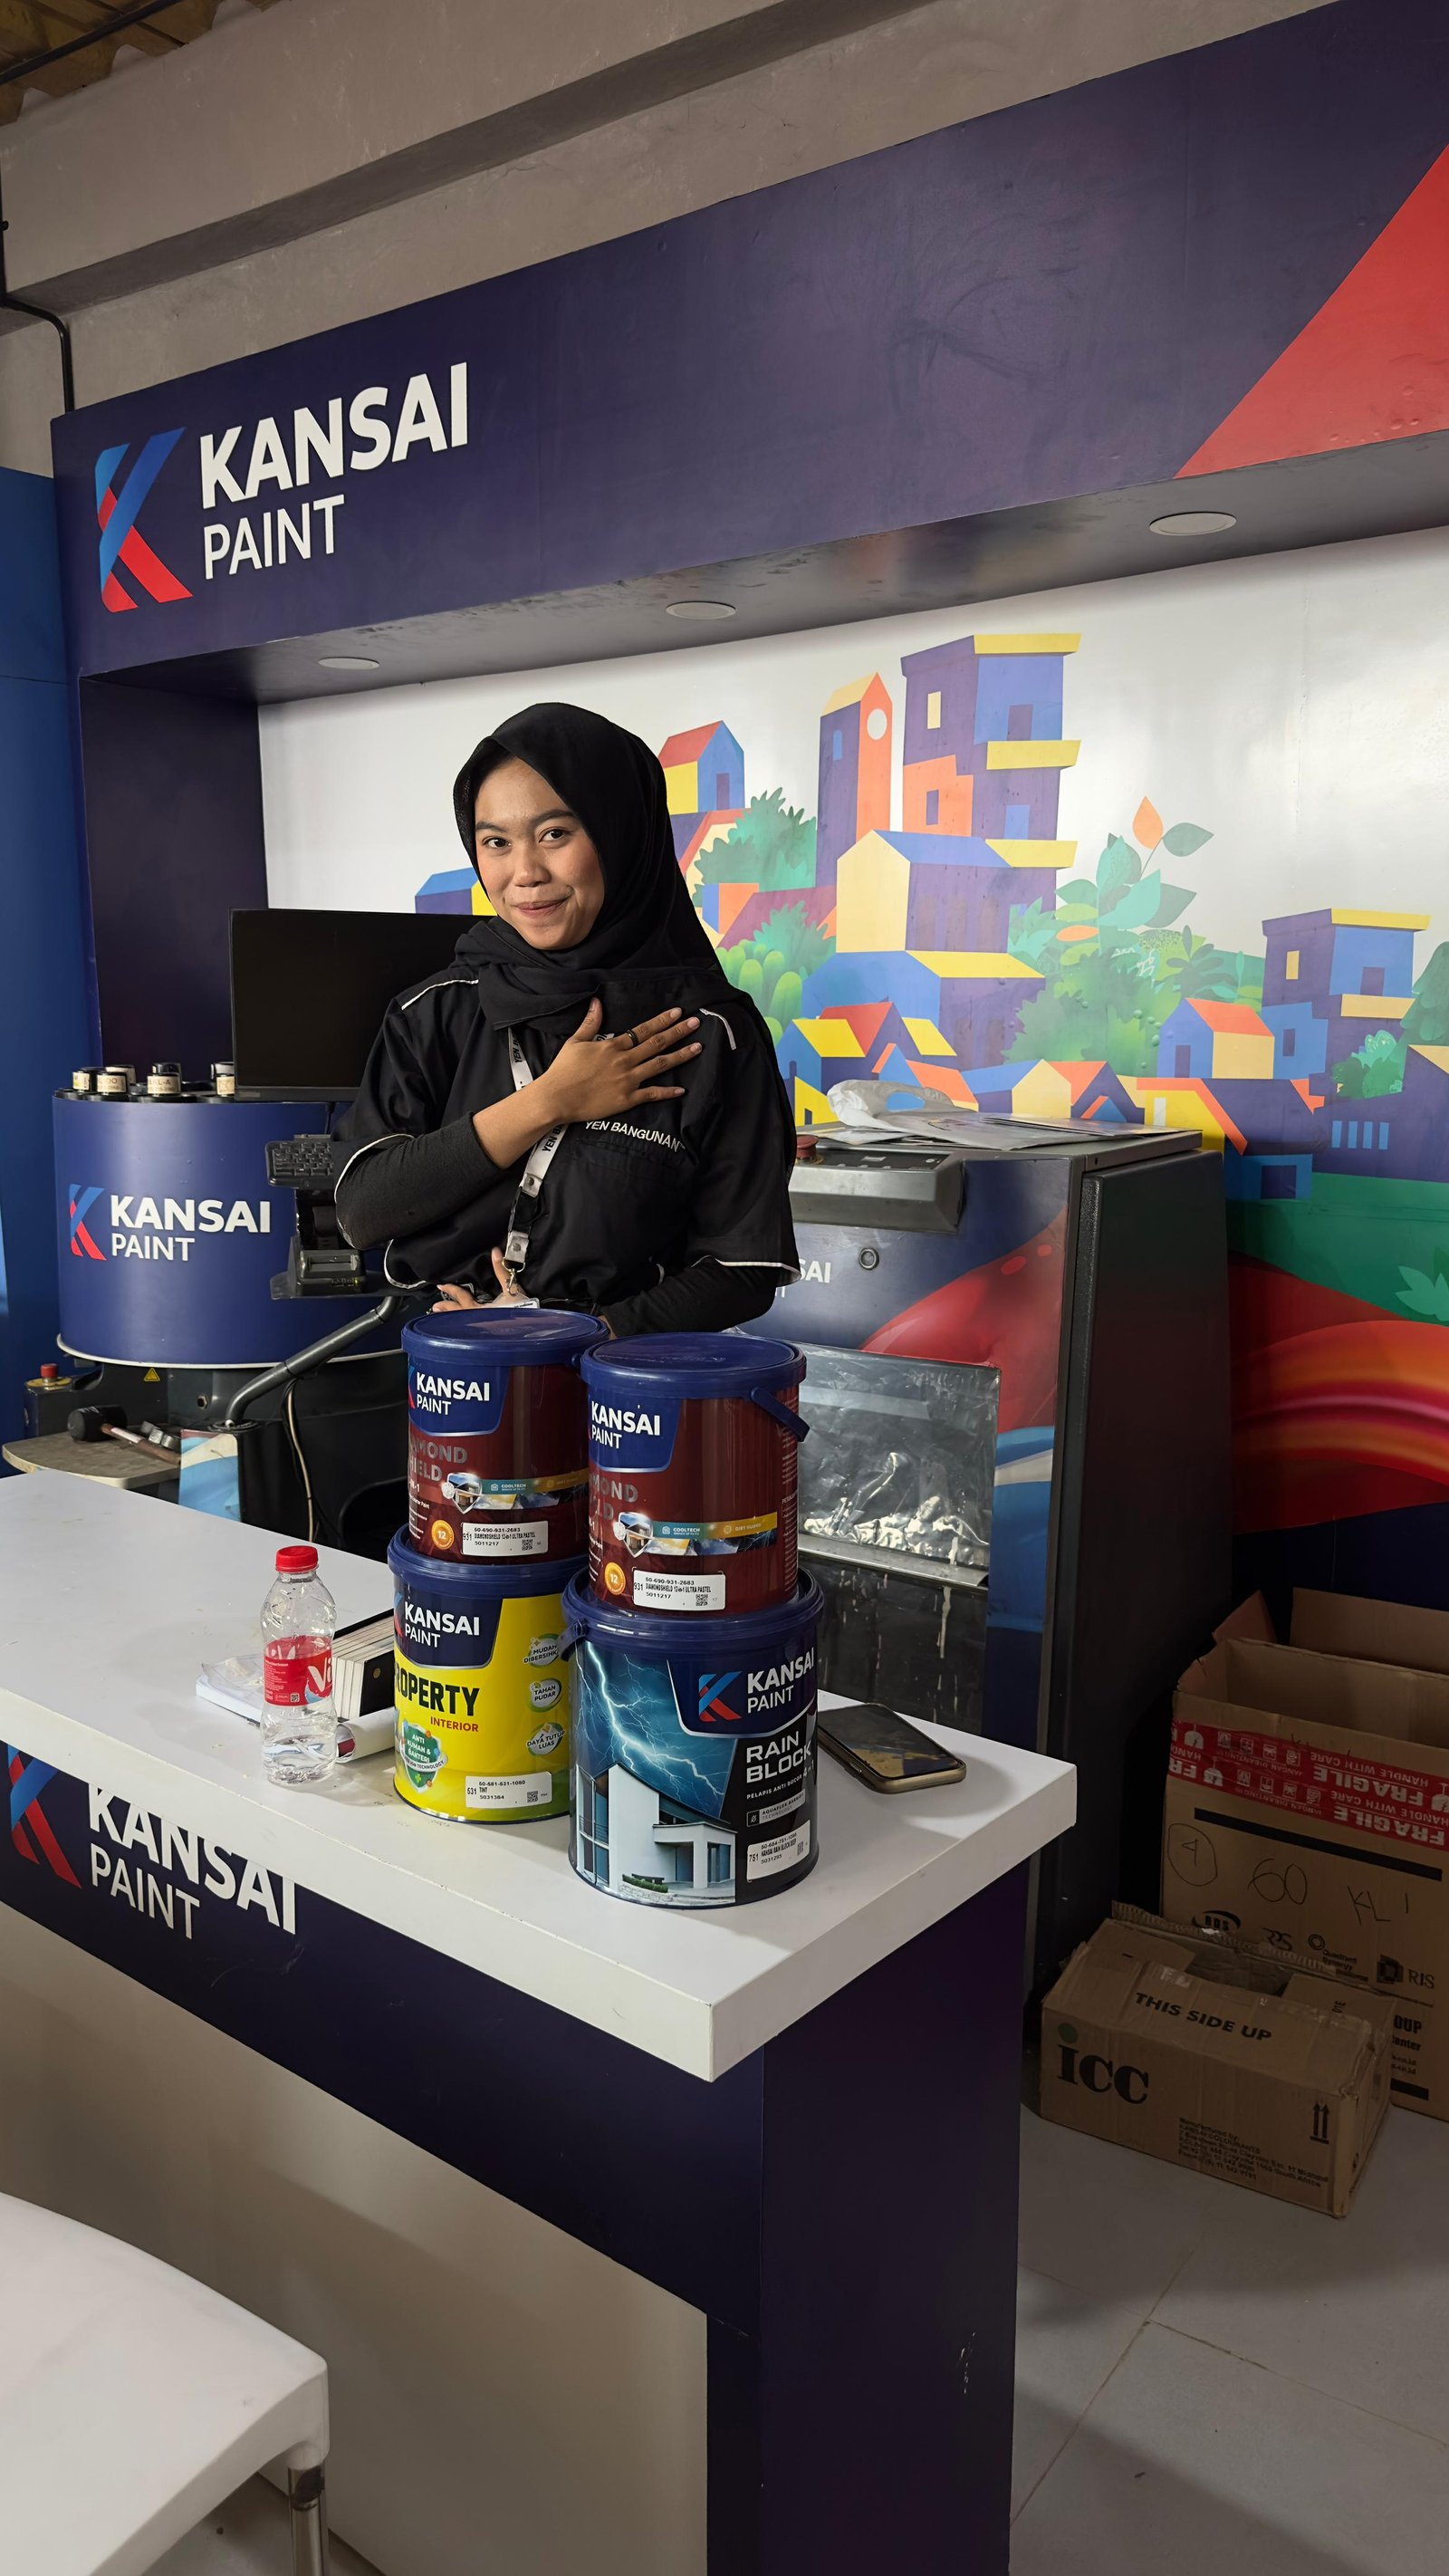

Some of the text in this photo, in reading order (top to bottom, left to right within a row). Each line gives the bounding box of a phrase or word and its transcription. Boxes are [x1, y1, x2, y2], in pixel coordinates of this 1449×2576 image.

[200, 362, 468, 509] KANSAI
[203, 495, 345, 580] PAINT
[542, 1136, 558, 1153] YEN
[610, 1121, 681, 1153] BANGUNAN
[110, 1195, 271, 1234] KANSAI
[111, 1233, 196, 1262] PAINT
[416, 1371, 490, 1402] KANSAI
[417, 1396, 452, 1416] PAINT
[590, 1400, 661, 1437] KANSAI
[591, 1427, 623, 1449] PAINT
[437, 1530, 446, 1540] 12
[609, 1573, 619, 1584] 12
[634, 1582, 644, 1591] 931
[404, 1600, 480, 1636] KANSAI
[405, 1623, 441, 1648] PAINT
[523, 1649, 559, 1663] DIBERSIHK
[533, 1644, 557, 1655] MUDAH
[747, 1647, 814, 1695] KANSAI
[533, 1685, 556, 1696] TAHAN
[534, 1691, 556, 1702] PUDAR
[747, 1685, 794, 1714] PAINT
[430, 1716, 479, 1732] INTERIOR
[407, 1739, 426, 1754] KUMAN
[411, 1734, 425, 1744] ANTI
[527, 1737, 544, 1746] DAYA
[539, 1741, 555, 1750] LUAS
[746, 1730, 800, 1764] RAIN
[408, 1749, 430, 1763] BAKTERI
[746, 1739, 812, 1783] BLOCK
[1310, 1751, 1429, 1788] HANDLE WITH CARE
[466, 1787, 477, 1795] 531
[746, 1788, 772, 1800] PELAPIS
[772, 1783, 787, 1792] ANTI
[1313, 1765, 1425, 1806] FRAGILE
[1330, 1790, 1362, 1805] CARE
[1365, 1799, 1396, 1814] WITH
[1333, 1804, 1445, 1846] FRAGILE
[88, 1783, 296, 1936] KANSAI
[91, 1842, 200, 1939] PAINT
[1407, 1968, 1435, 1989] RIS
[1136, 1993, 1272, 2041] THIS SIDE UP
